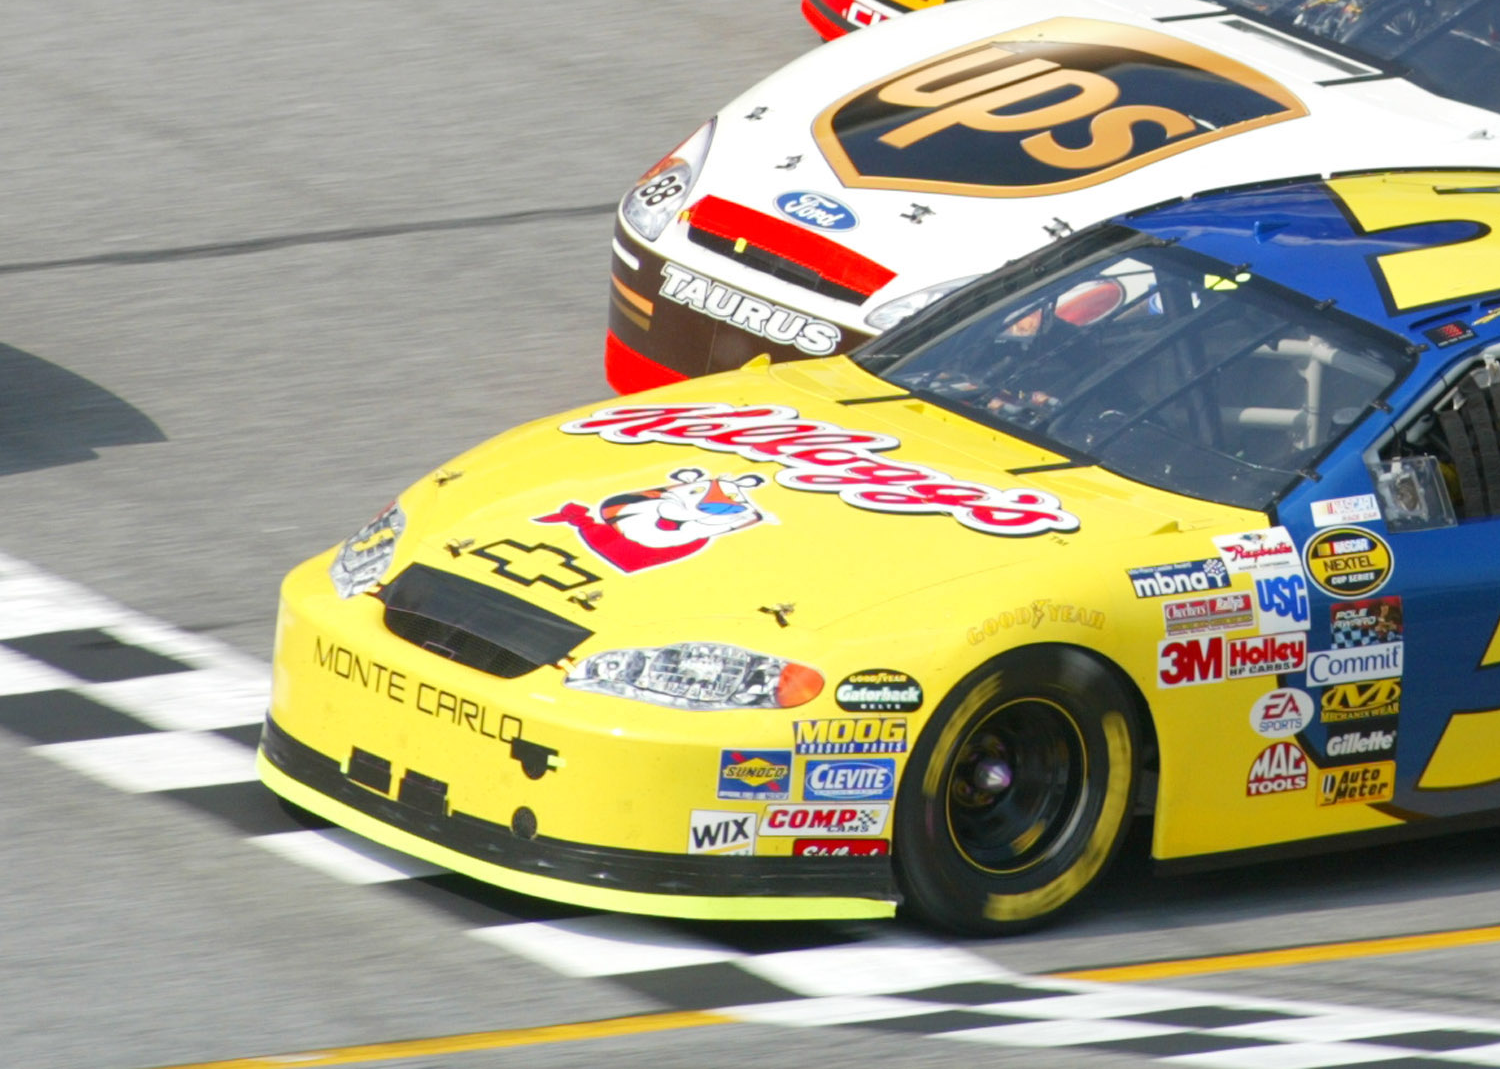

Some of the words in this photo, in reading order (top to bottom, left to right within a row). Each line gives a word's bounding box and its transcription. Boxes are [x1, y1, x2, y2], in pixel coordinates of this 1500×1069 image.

[639, 175, 682, 206] 88
[783, 194, 846, 228] Ford
[659, 261, 841, 355] TAURUS
[564, 405, 1077, 533] Kellogg's
[1323, 555, 1374, 572] NEXTEL
[1133, 570, 1208, 598] mbna
[1335, 608, 1368, 620] POLE
[1160, 637, 1222, 685] 3M
[1230, 637, 1305, 668] Holley
[1309, 645, 1398, 683] Commit
[314, 635, 406, 703] MONTE
[416, 682, 523, 744] CARLO
[837, 684, 920, 702] Gatorback
[1262, 693, 1301, 719] EA
[797, 719, 905, 743] MOOG
[1259, 718, 1302, 732] SPORTS
[800, 743, 854, 755] CHASSIS
[863, 742, 901, 753] PARTS
[1326, 731, 1395, 756] Gillette
[726, 765, 785, 778] SUNOCO
[1249, 743, 1307, 781] MAC
[811, 764, 888, 790] CLEVITE
[1248, 776, 1306, 795] TOOLS
[1340, 767, 1380, 783] Auto
[1336, 782, 1388, 800] Meter
[768, 809, 858, 829] COMP
[827, 823, 870, 833] CAMS
[692, 817, 750, 848] WIX
